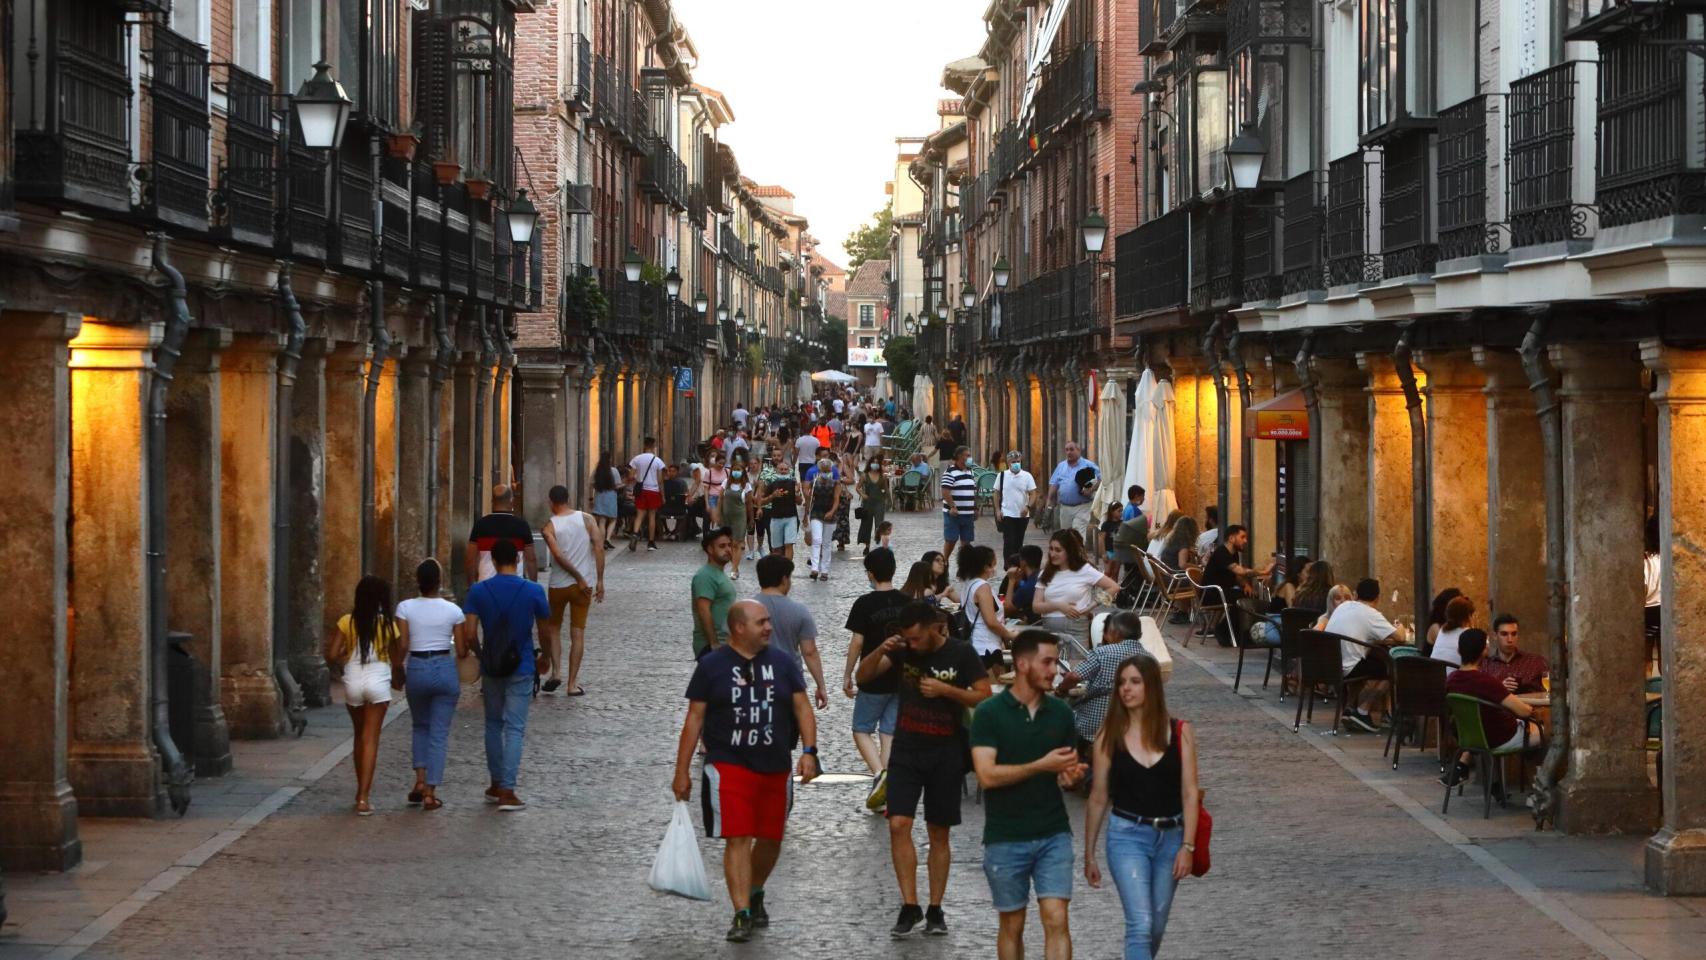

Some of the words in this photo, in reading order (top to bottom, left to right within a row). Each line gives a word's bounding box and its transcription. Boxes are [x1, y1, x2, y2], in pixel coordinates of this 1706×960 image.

[731, 685, 775, 704] PLE
[732, 706, 773, 724] THI
[730, 729, 774, 747] NGS
